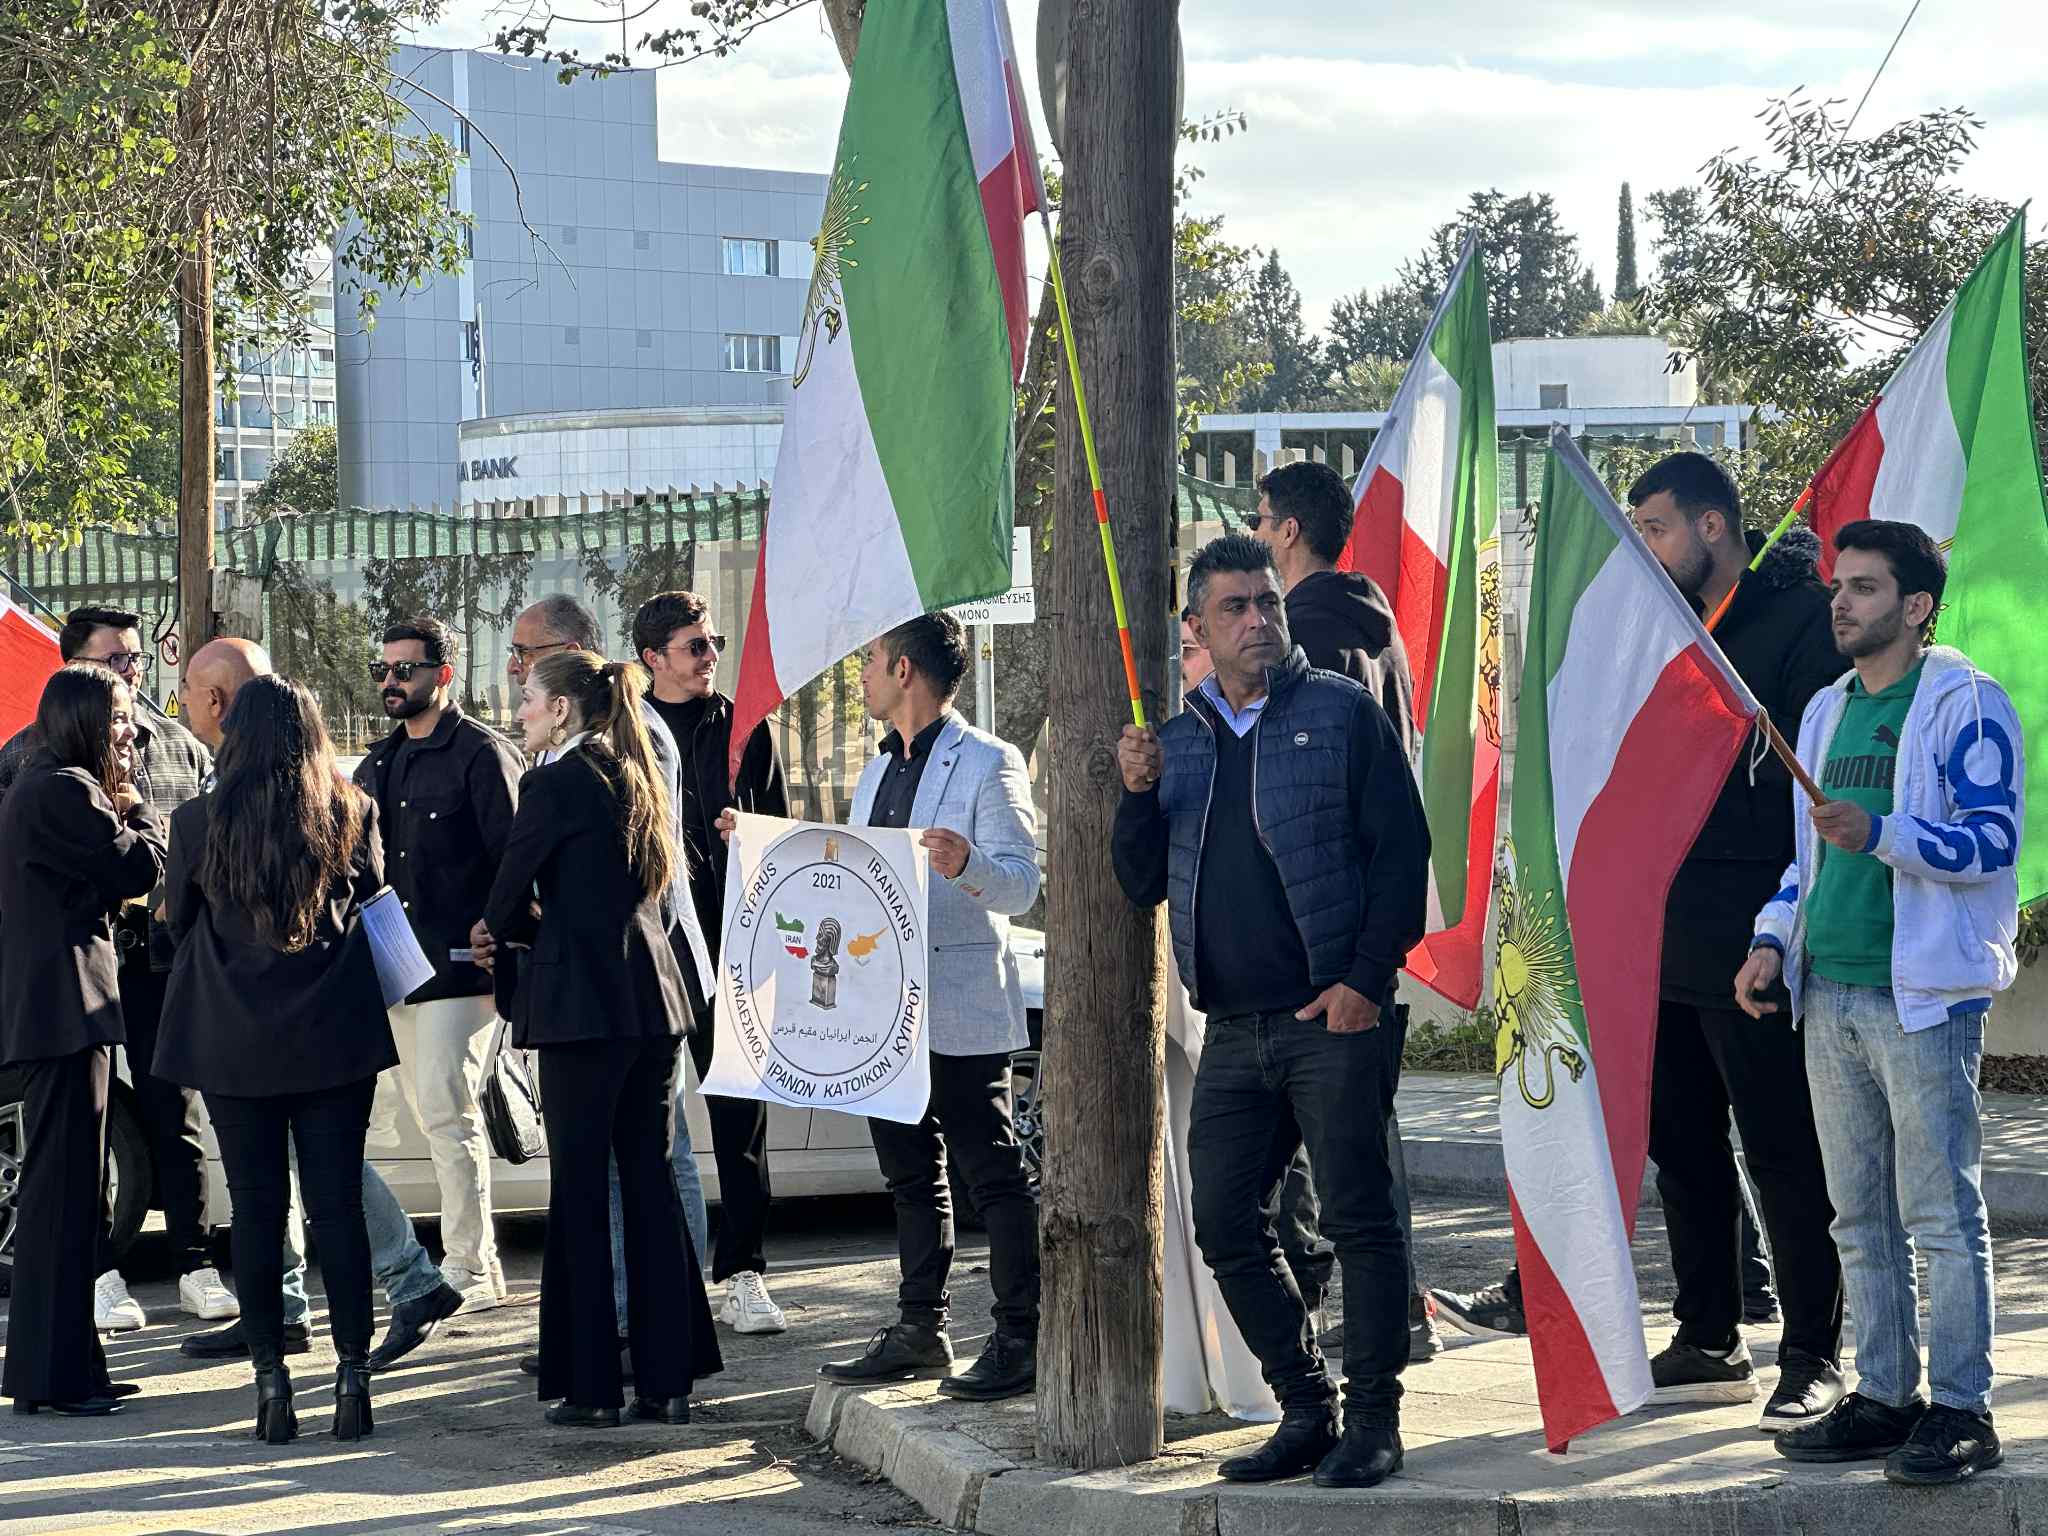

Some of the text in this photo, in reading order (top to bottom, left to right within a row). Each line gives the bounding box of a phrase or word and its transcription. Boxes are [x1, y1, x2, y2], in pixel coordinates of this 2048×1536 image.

[471, 456, 519, 480] BANK
[1824, 754, 1897, 790] PUMA
[812, 872, 841, 890] 2021
[740, 857, 914, 942] CYPRUS IRANIANS
[785, 935, 801, 945] IRAN
[730, 962, 921, 1098] ΣΥΝΔΕΣΜΟΣ ΙΡΑΝΩΝ ΚΑΤΟΙΚΩΝ ΚΥΠΡΟΥ
[853, 1032, 877, 1045] انجمن
